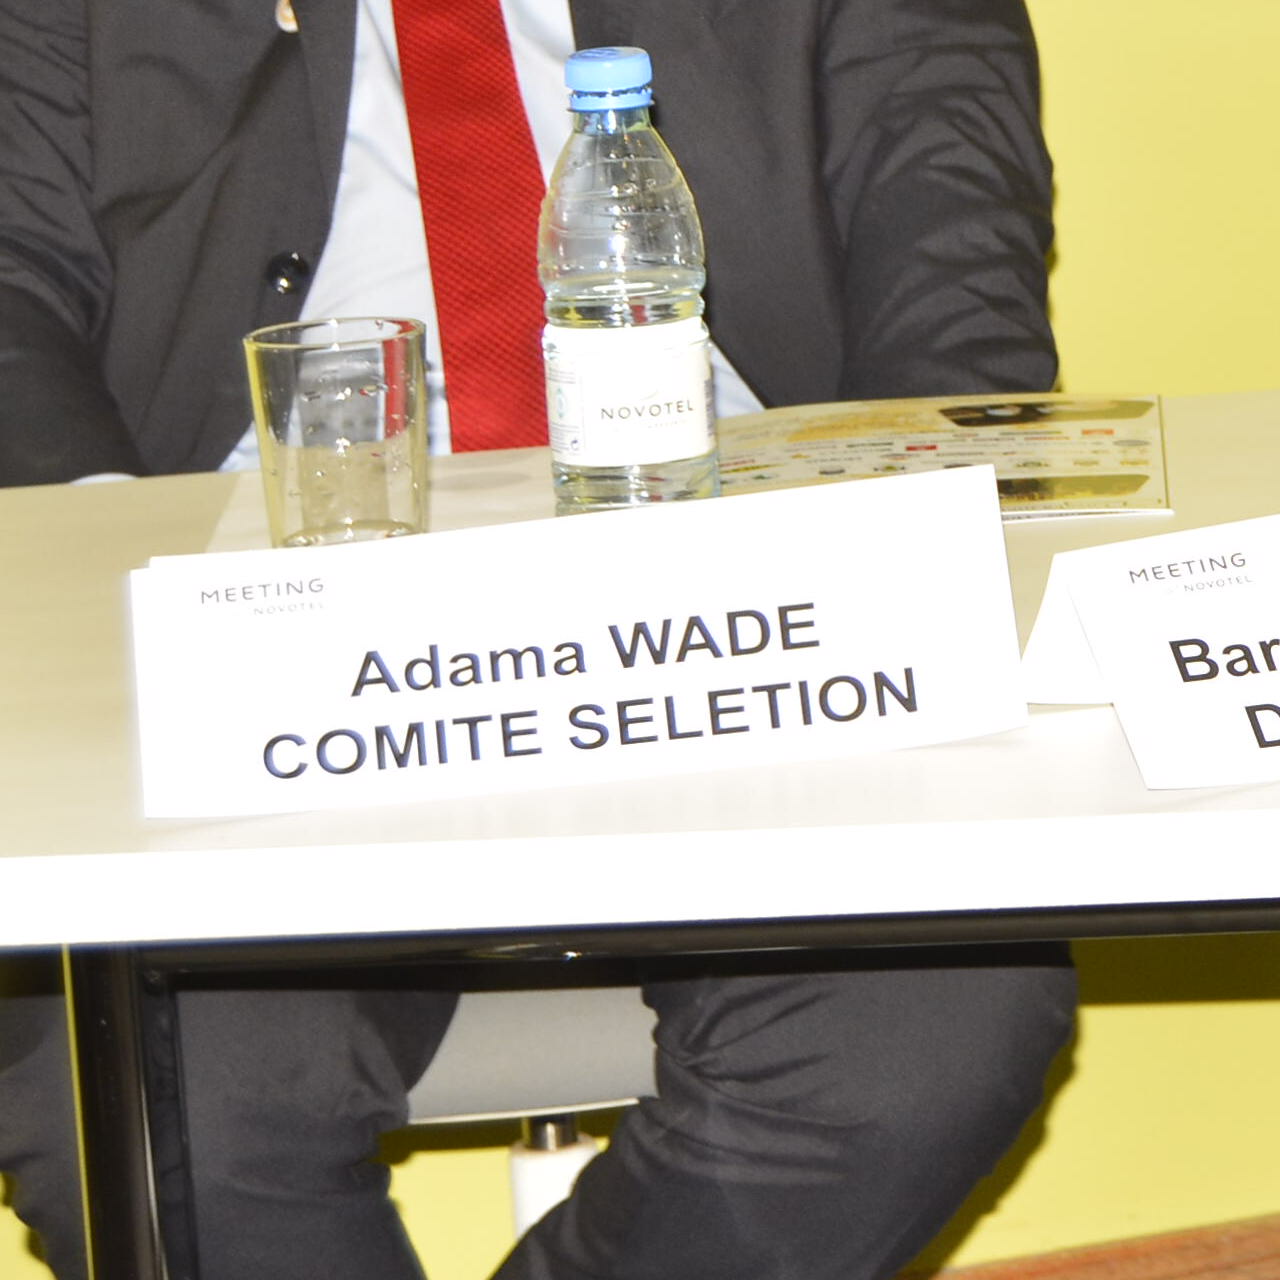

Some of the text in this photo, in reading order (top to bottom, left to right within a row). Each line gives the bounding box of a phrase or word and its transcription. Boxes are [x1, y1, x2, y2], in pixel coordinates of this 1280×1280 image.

[600, 399, 695, 420] NOVOTEL
[1128, 552, 1248, 585] MEETING
[200, 577, 325, 605] MEETING
[1183, 575, 1255, 592] NOVOTEL
[252, 601, 325, 616] NOVOTEL
[351, 602, 820, 697] Adama WADE
[263, 667, 918, 780] COMITE SELETION
